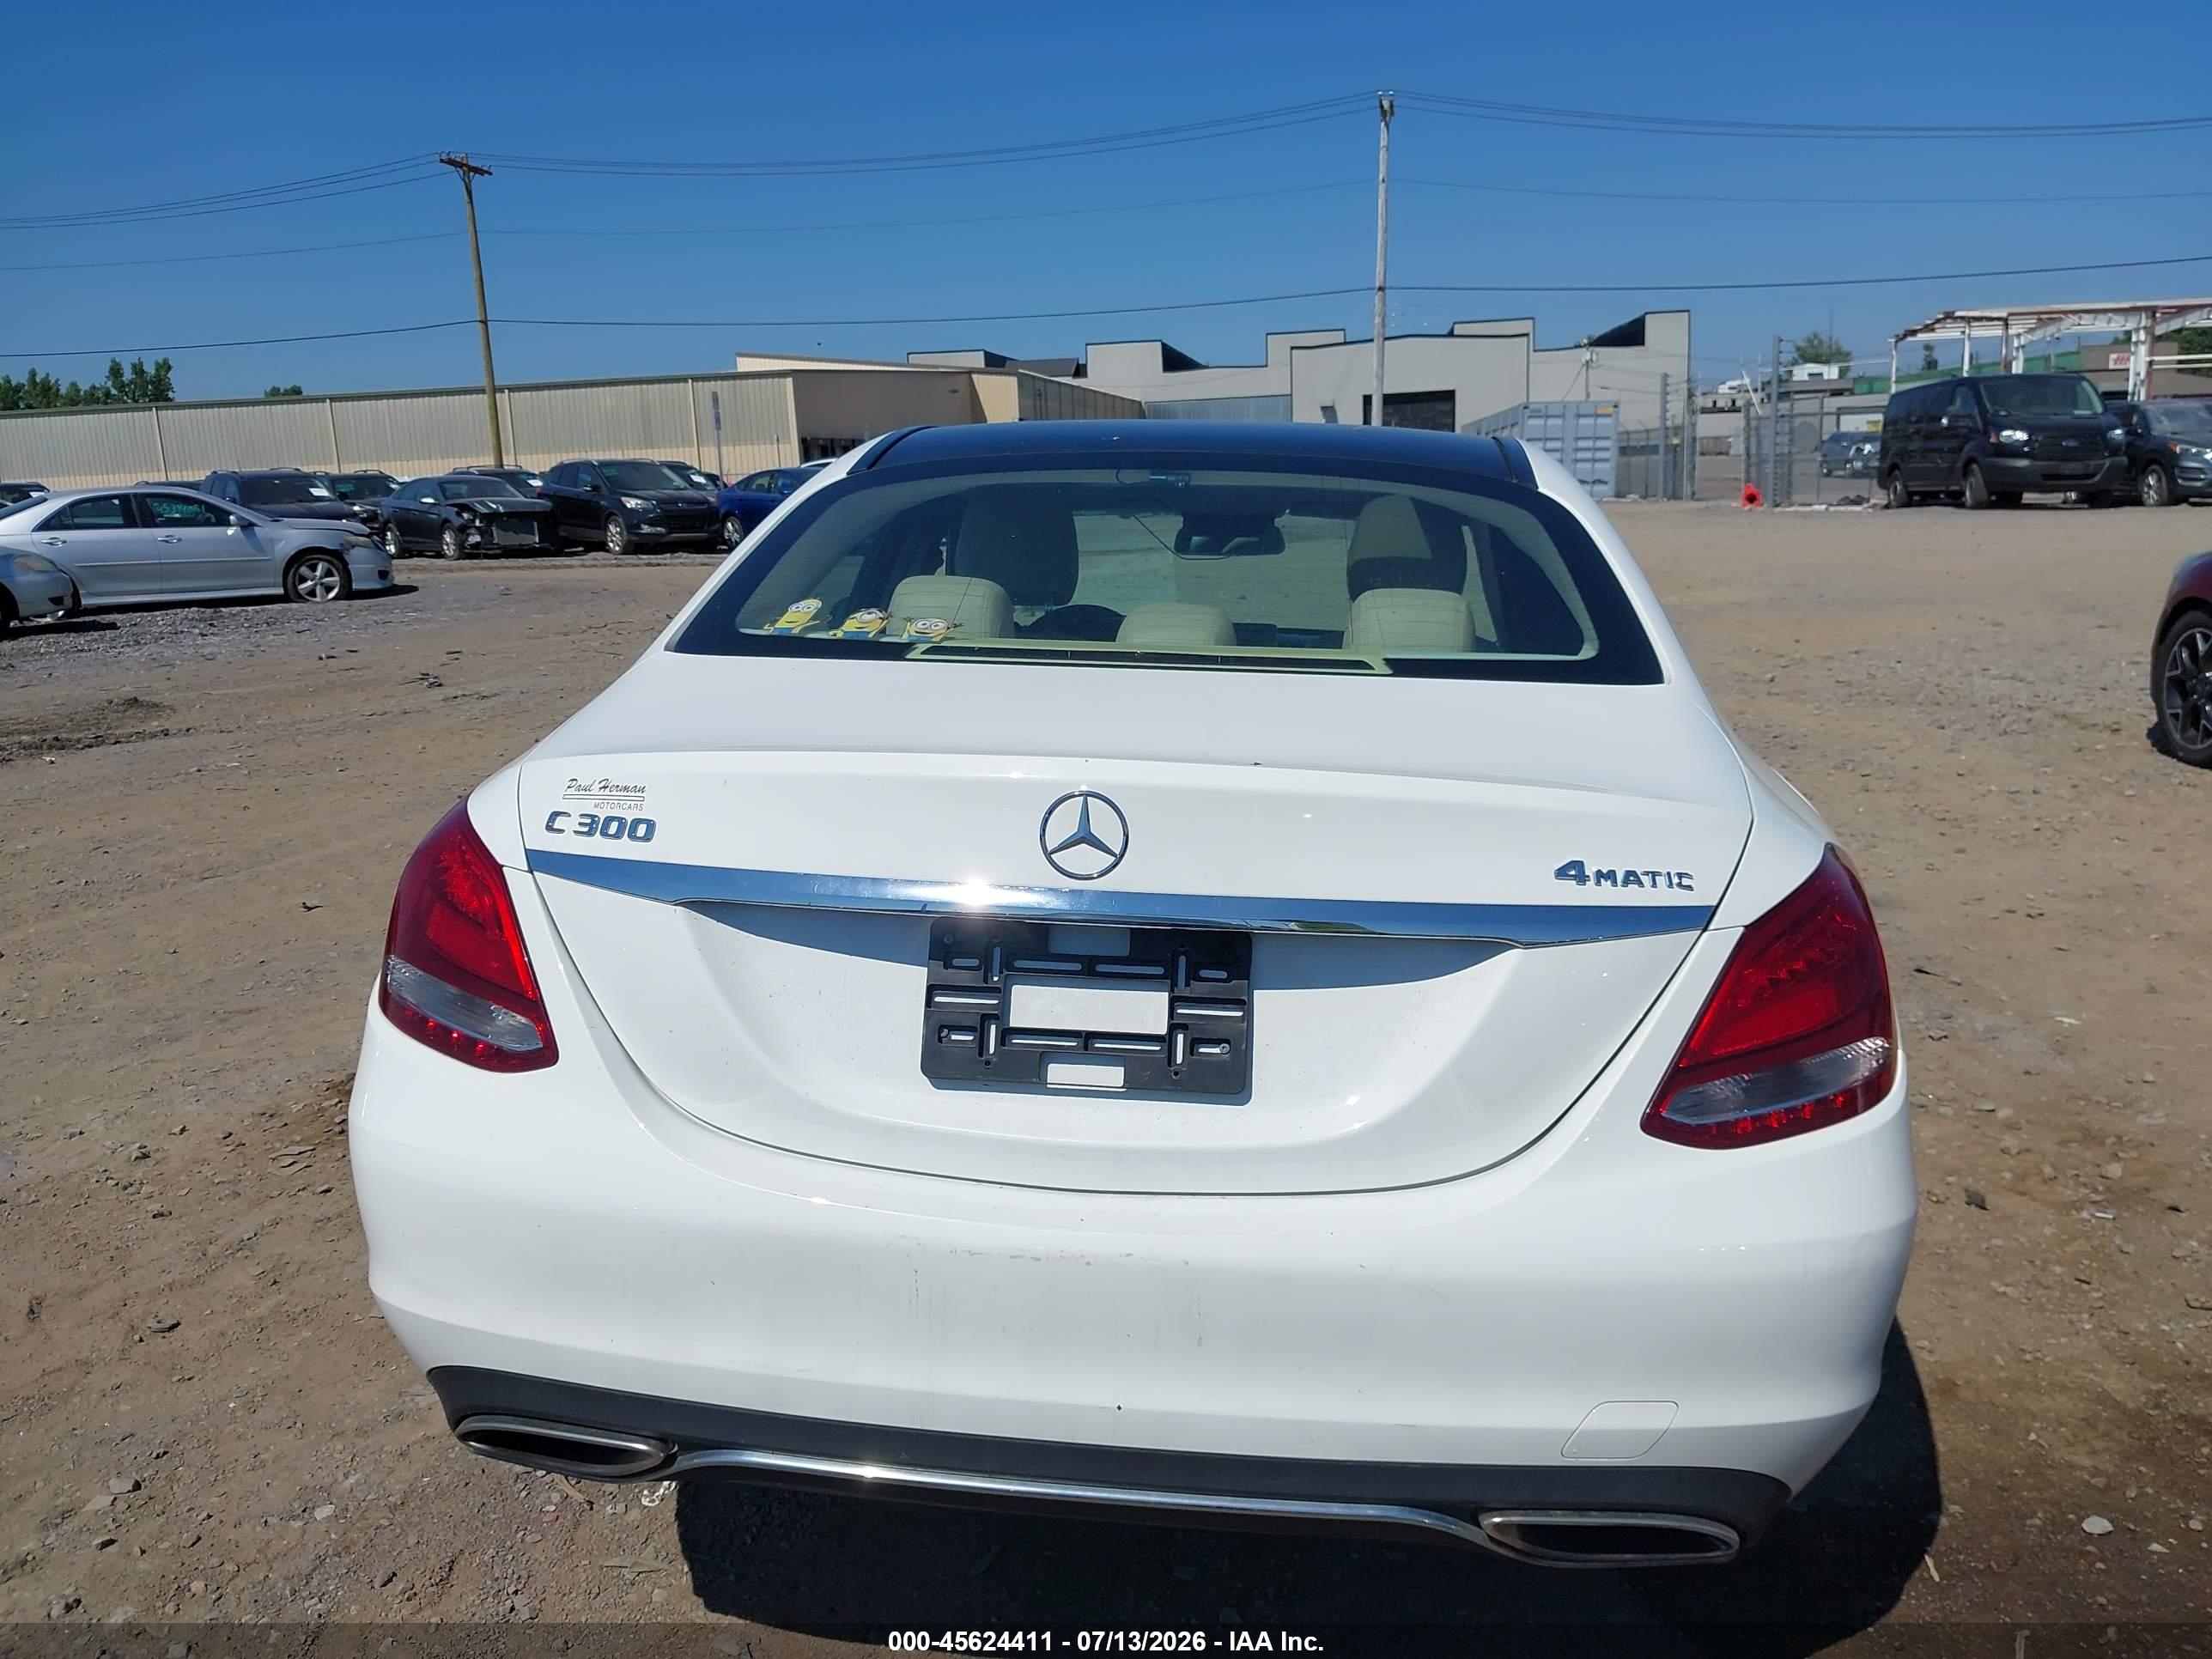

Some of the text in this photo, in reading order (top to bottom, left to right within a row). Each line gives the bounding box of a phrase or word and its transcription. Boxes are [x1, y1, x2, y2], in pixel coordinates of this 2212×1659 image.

[565, 778, 647, 794] Paul Herman
[593, 801, 644, 811] MOTORCARS
[1553, 860, 1695, 891] 4MATIC
